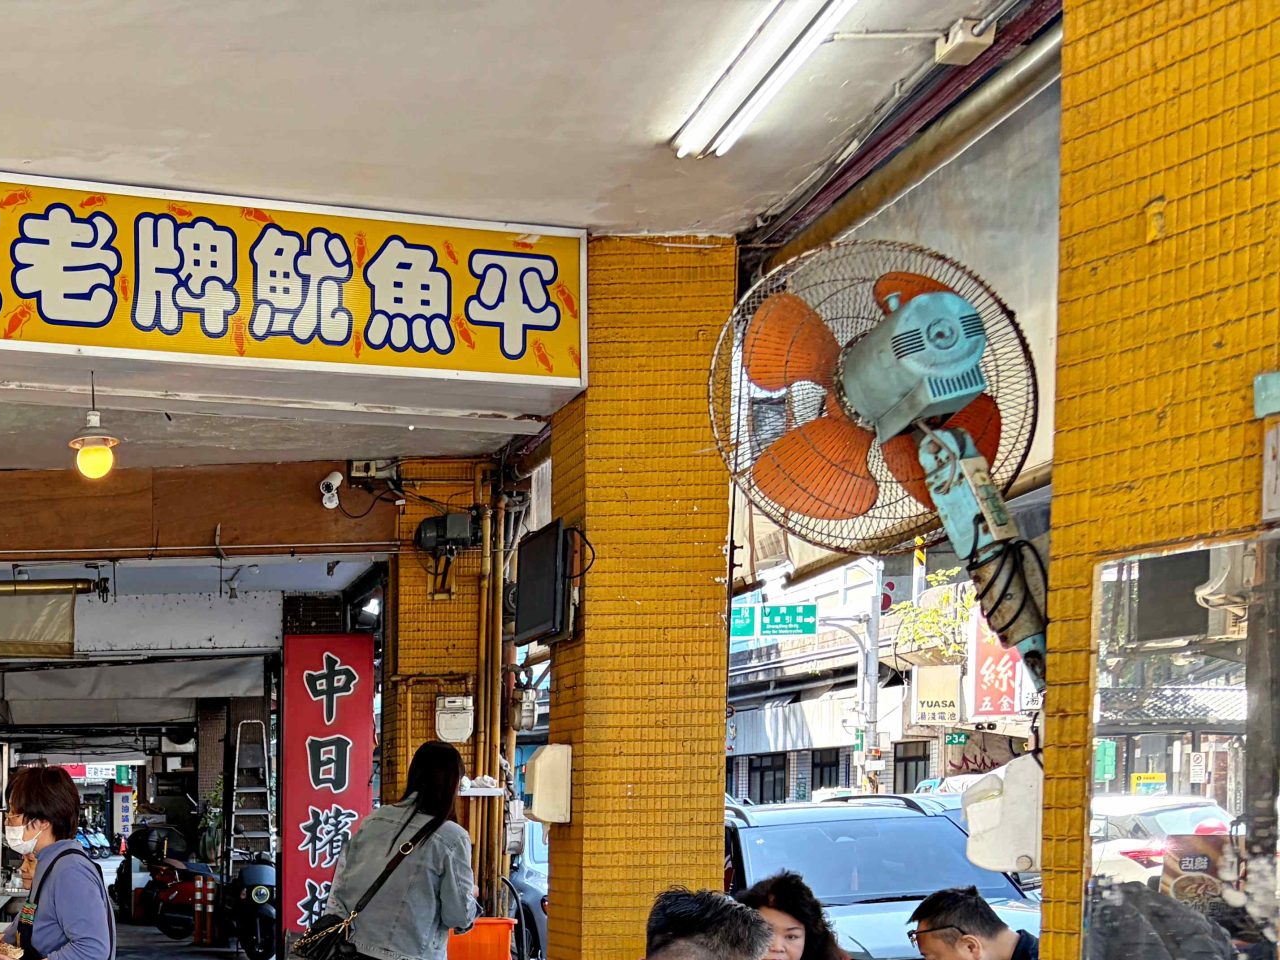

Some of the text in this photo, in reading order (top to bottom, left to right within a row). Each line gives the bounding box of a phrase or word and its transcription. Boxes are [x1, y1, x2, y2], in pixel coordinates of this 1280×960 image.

[919, 700, 956, 708] YUASA
[978, 695, 1015, 712] 五金
[945, 734, 966, 744] P34
